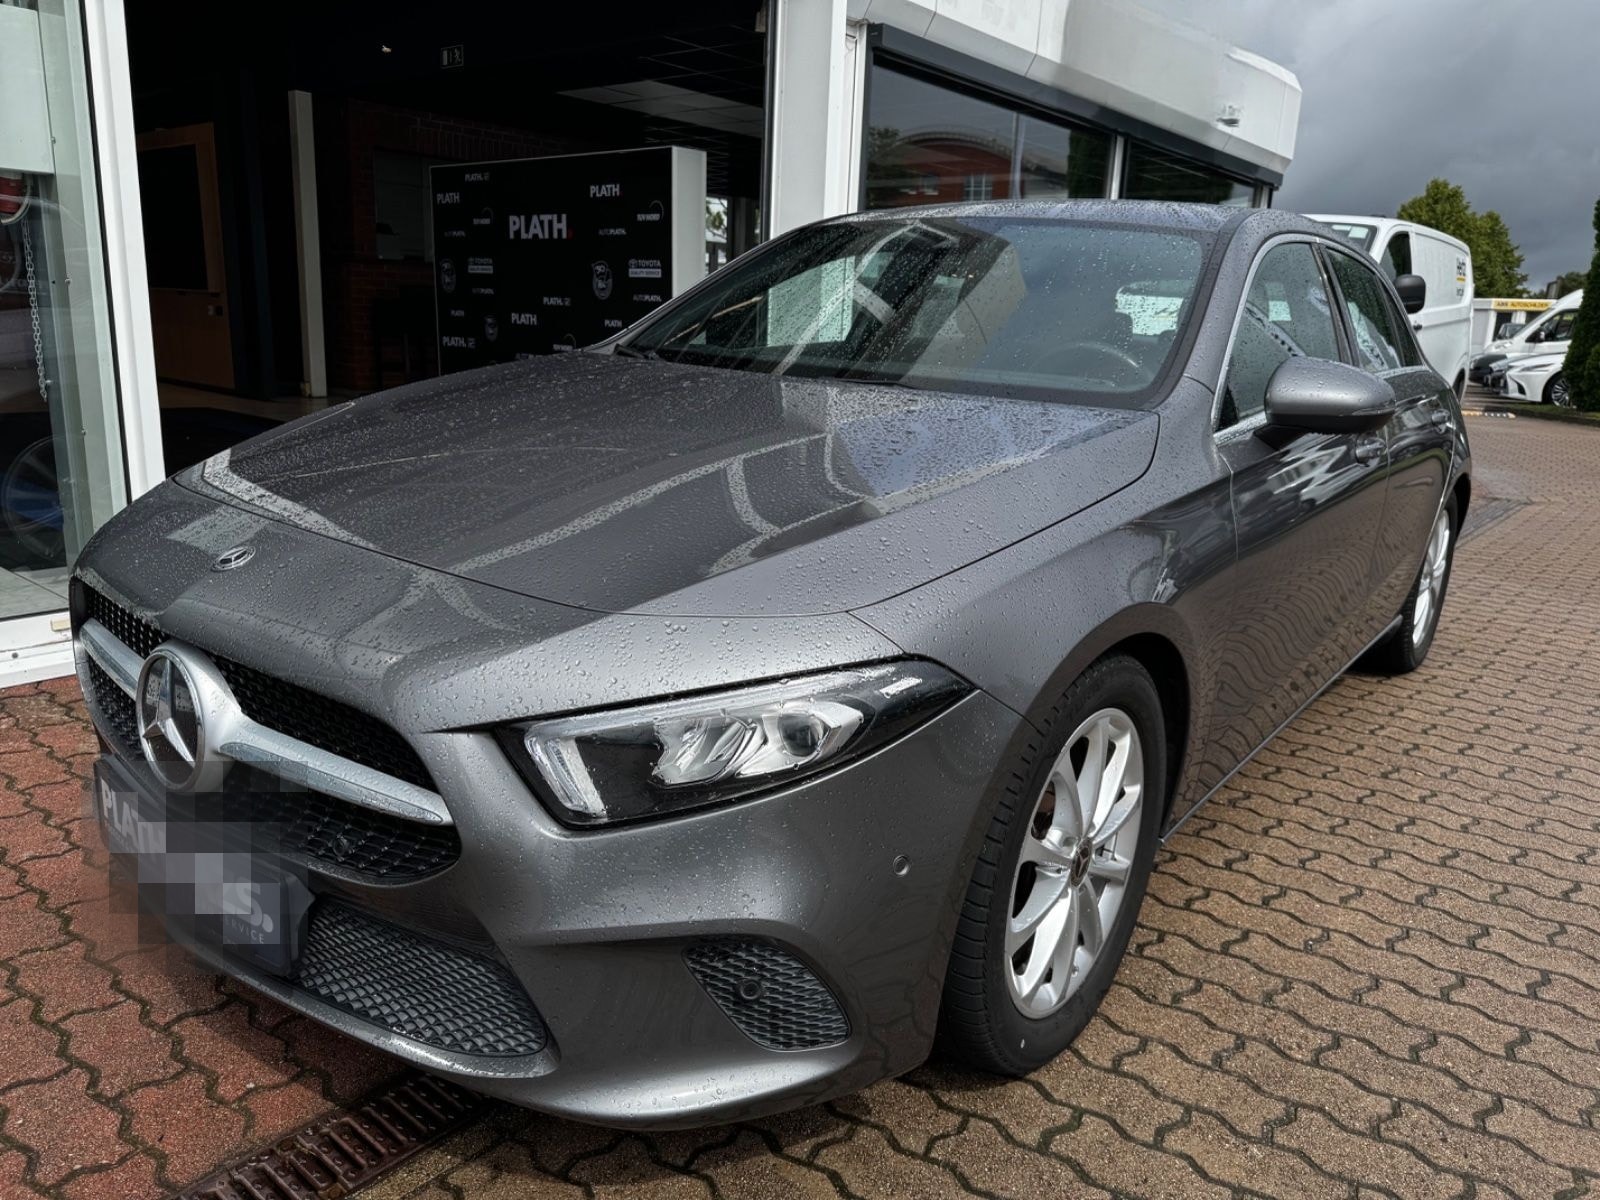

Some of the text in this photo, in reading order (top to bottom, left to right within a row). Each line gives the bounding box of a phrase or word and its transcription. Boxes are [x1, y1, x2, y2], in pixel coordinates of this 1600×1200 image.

[436, 192, 460, 205] PLATH
[638, 259, 662, 268] TOYOTA
[511, 312, 538, 325] PLATH
[604, 319, 623, 328] PLATH
